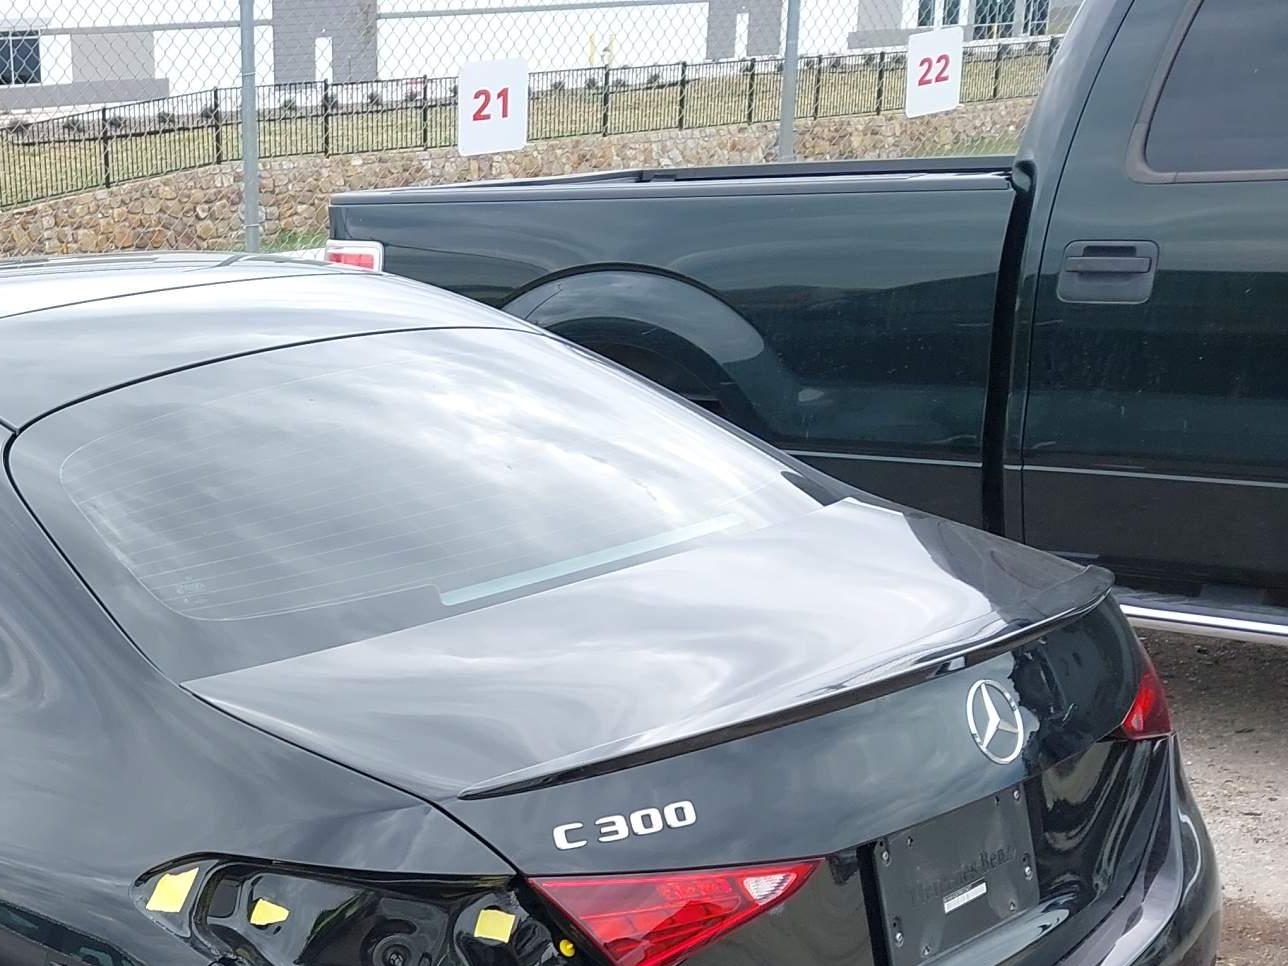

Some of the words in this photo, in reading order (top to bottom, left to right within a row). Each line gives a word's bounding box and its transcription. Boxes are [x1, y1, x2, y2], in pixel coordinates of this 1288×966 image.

[918, 54, 950, 86] 22
[472, 87, 509, 121] 21
[552, 822, 588, 850] C
[594, 800, 697, 842] 300
